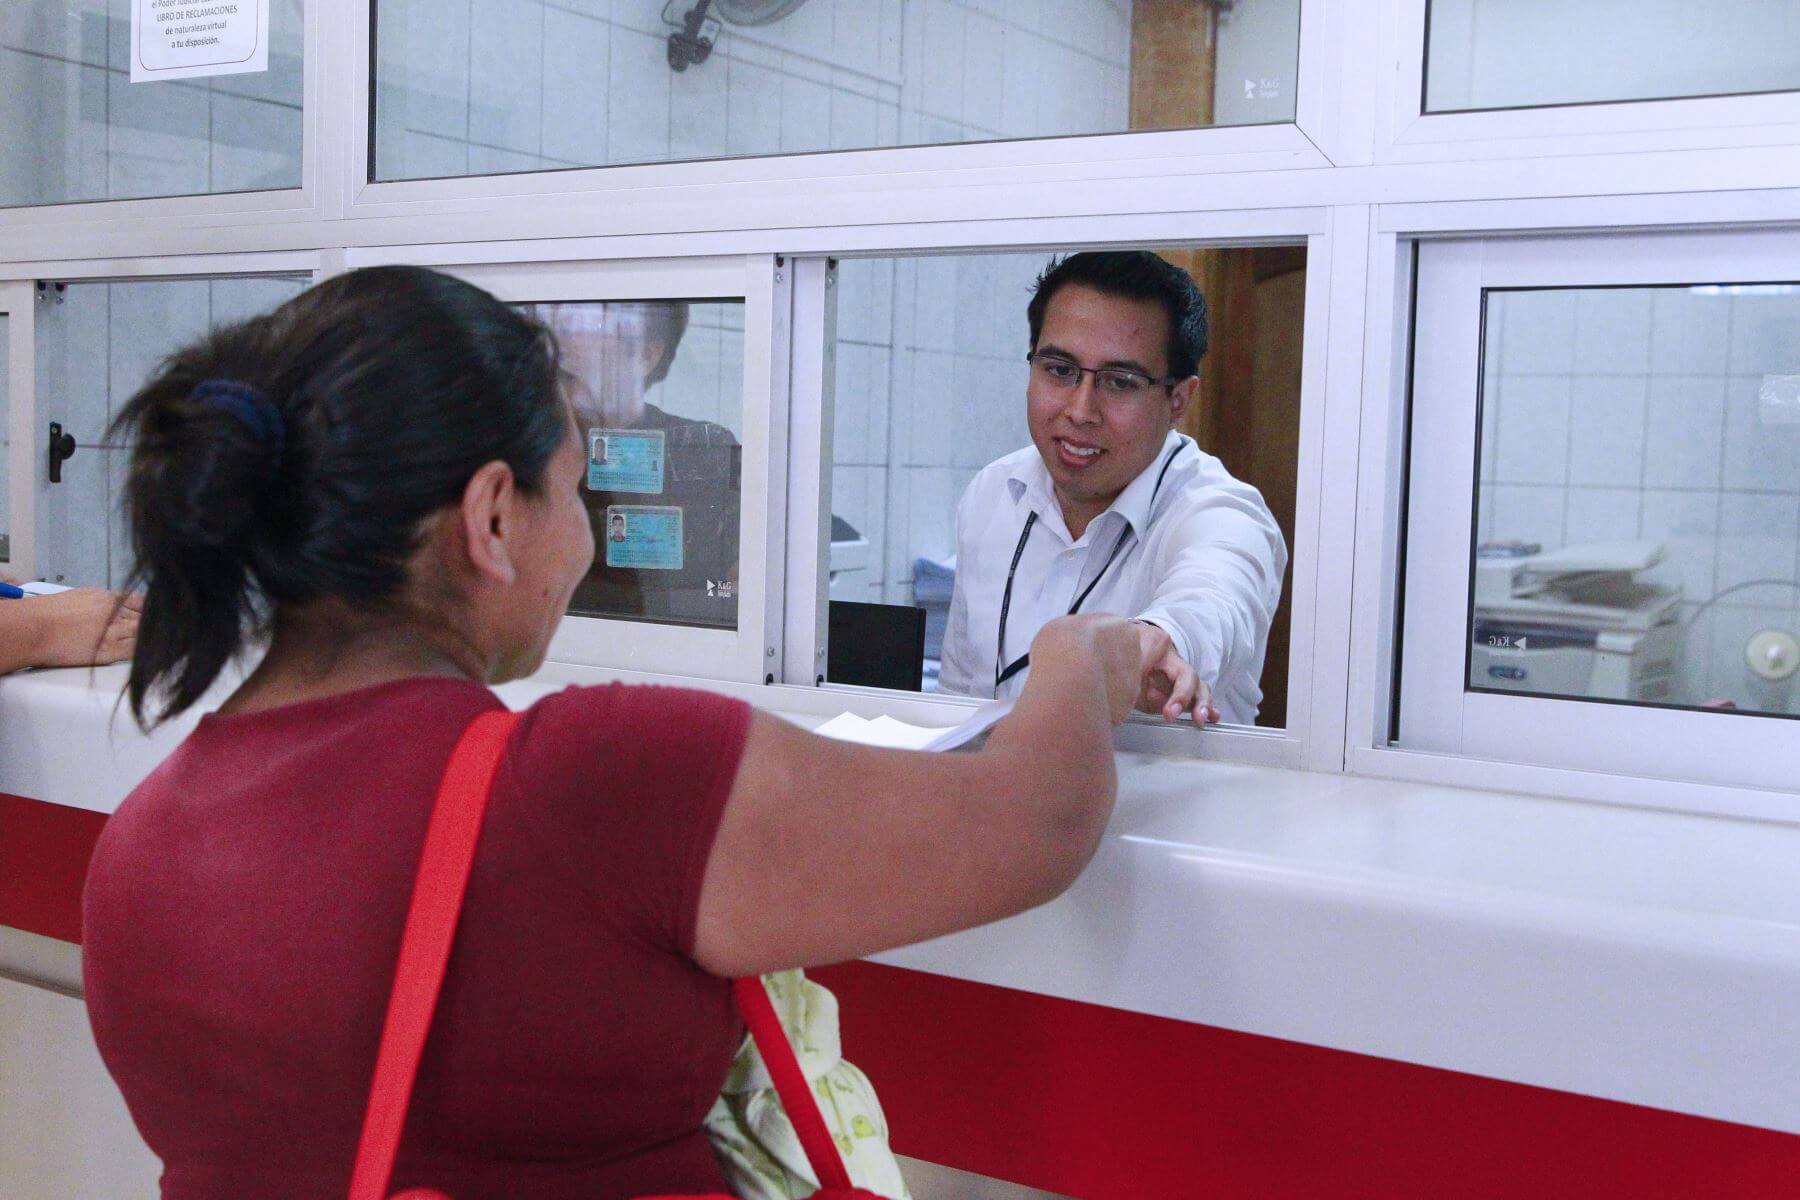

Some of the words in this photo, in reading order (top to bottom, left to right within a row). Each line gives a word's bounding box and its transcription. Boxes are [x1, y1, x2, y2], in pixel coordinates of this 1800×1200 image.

[156, 12, 174, 22] LIBRO
[176, 11, 184, 20] DE
[186, 5, 237, 18] RECLAMACIONES
[165, 26, 173, 35] de
[174, 24, 206, 34] naturaleza
[207, 20, 227, 30] virtual
[177, 40, 184, 48] tu
